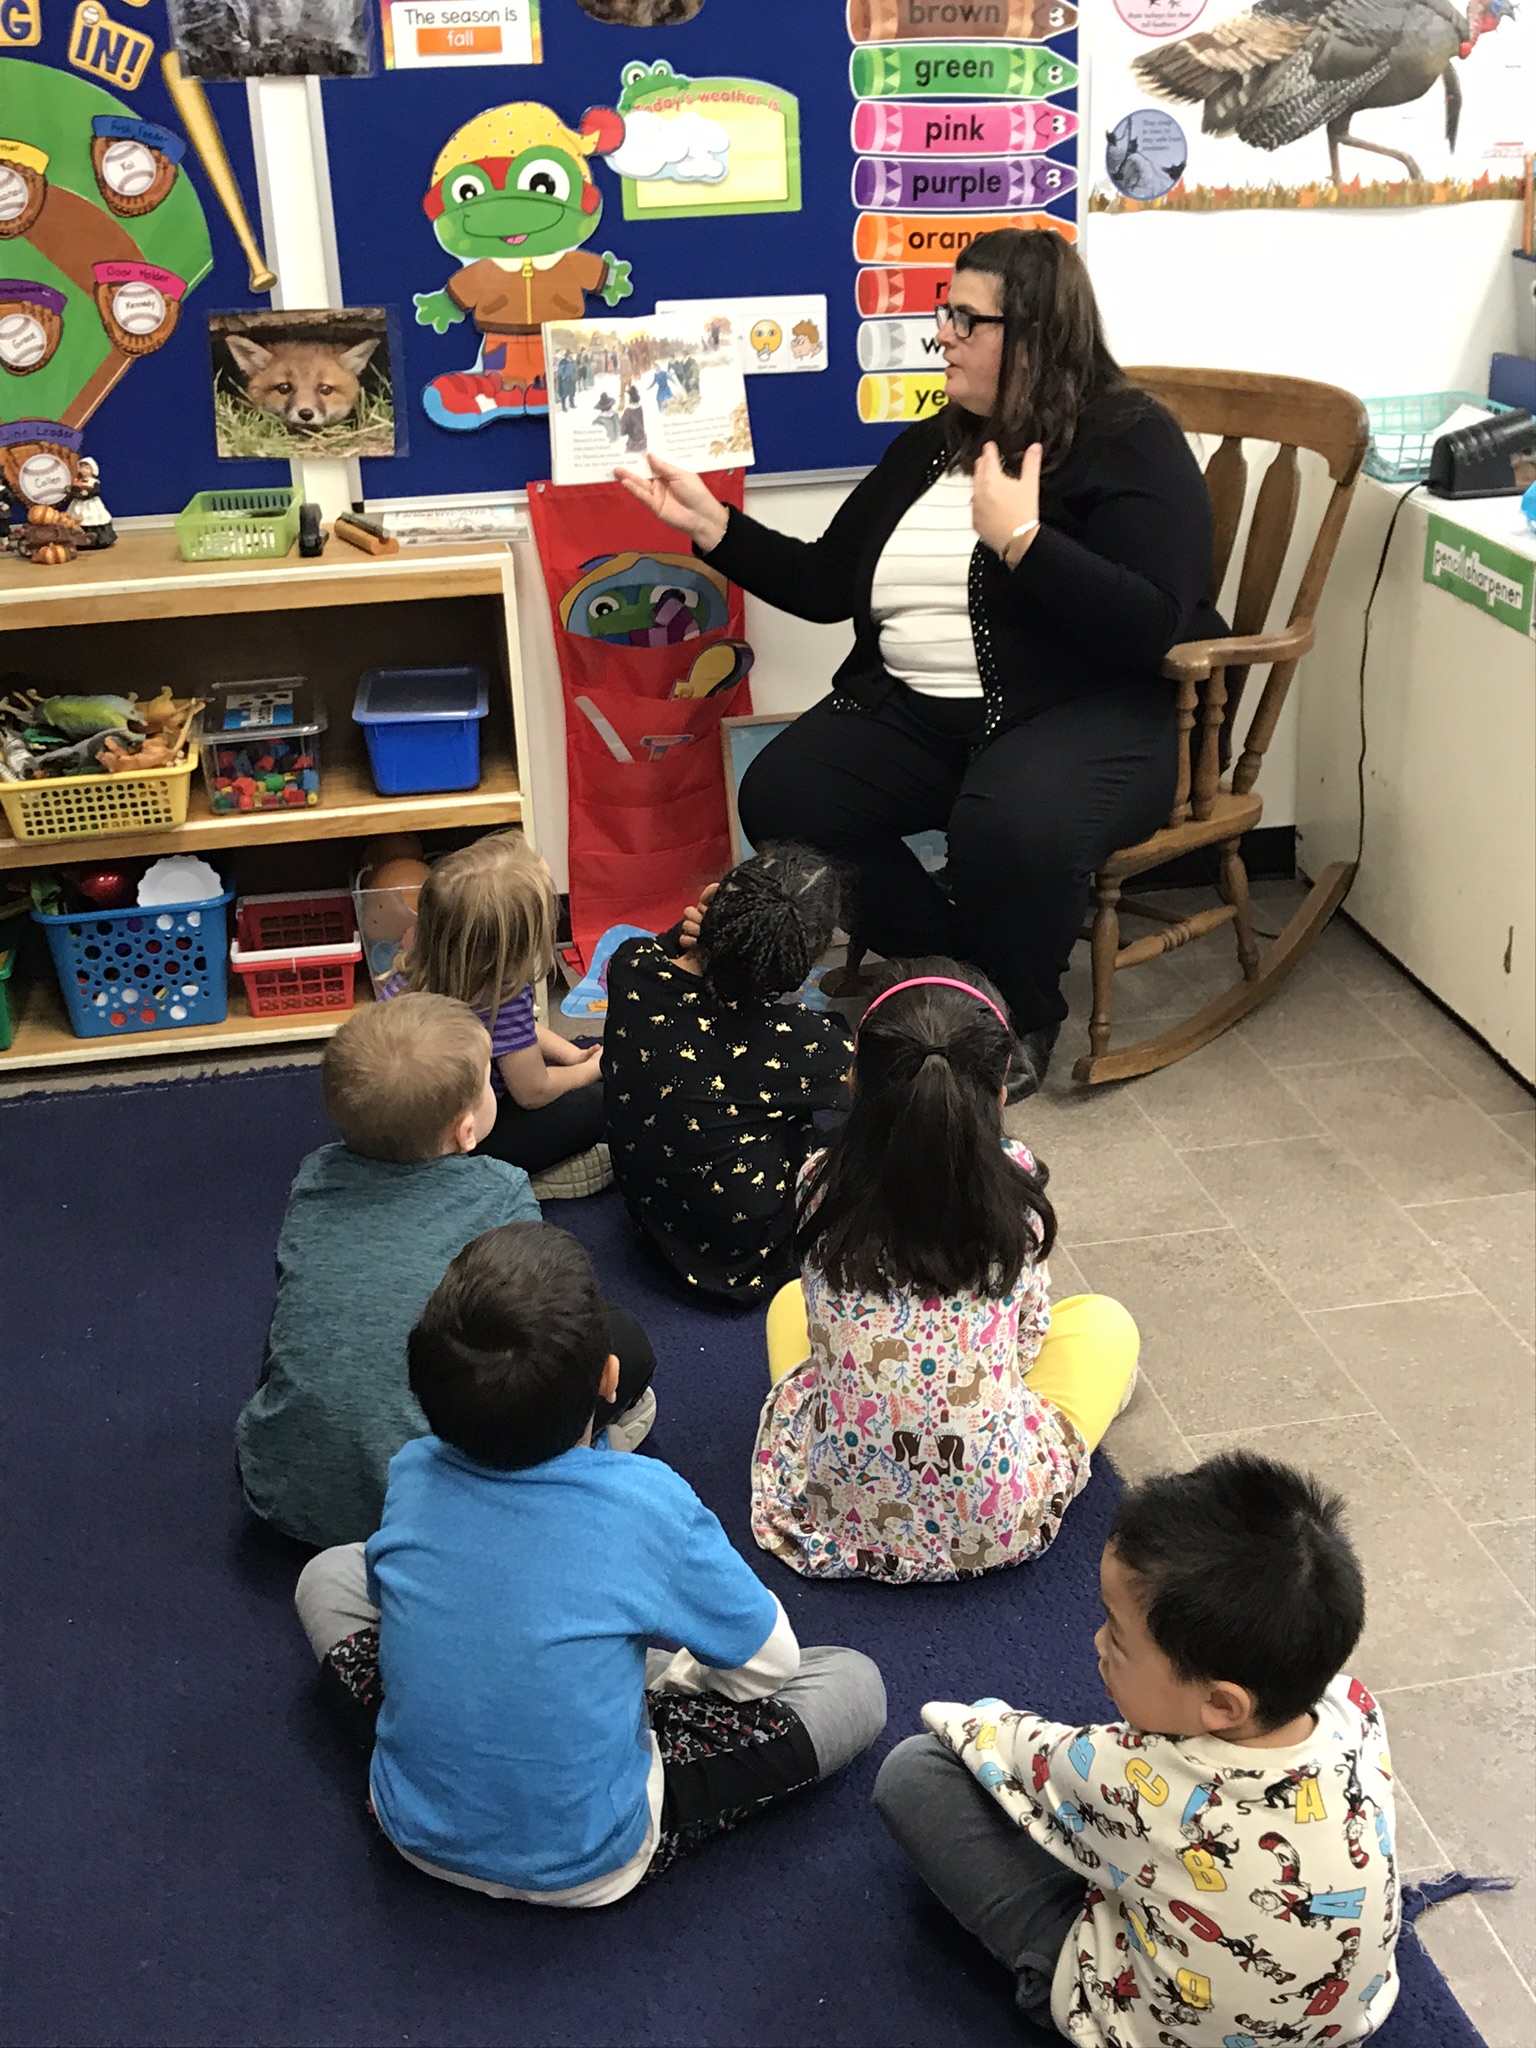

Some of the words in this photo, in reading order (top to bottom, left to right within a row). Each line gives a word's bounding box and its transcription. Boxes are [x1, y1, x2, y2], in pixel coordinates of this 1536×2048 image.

[404, 8, 436, 25] The
[440, 9, 500, 24] season
[504, 7, 518, 22] is
[908, 0, 1000, 25] brown
[446, 30, 475, 47] fall
[914, 59, 994, 87] green
[698, 90, 763, 106] weather
[768, 97, 781, 112] is
[925, 114, 985, 148] pink
[912, 167, 1002, 202] purple
[106, 265, 132, 277] Door
[139, 269, 170, 282] Holder
[36, 426, 74, 439] Leader
[1295, 1776, 1328, 1824] A
[1182, 1848, 1227, 1893] B
[1309, 1886, 1367, 1920] A
